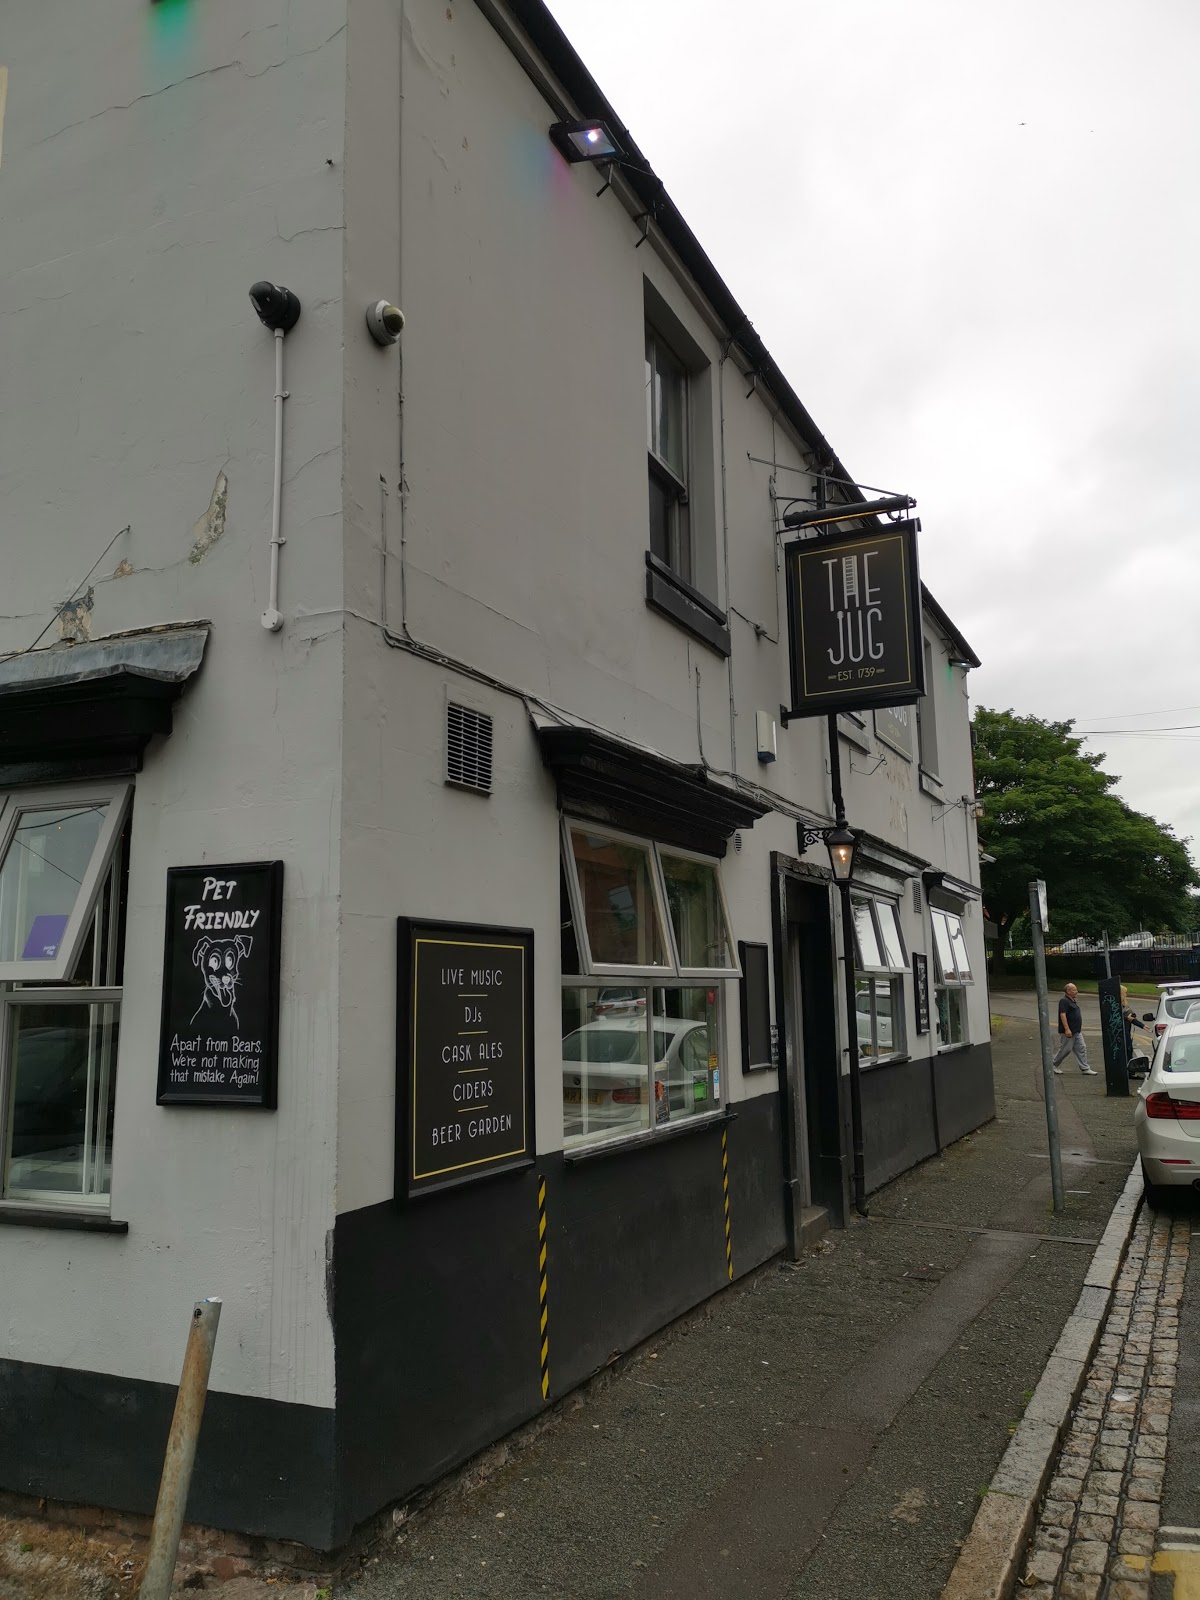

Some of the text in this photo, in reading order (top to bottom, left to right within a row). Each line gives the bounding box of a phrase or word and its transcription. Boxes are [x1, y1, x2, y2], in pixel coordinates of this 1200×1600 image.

[822, 551, 881, 611] THE
[827, 607, 884, 665] JUG
[837, 666, 876, 681] EST. 1739
[202, 877, 237, 901] PET
[184, 905, 260, 931] FRIENDLY
[441, 968, 503, 986] LIVE MUSIC
[465, 1006, 482, 1023] DJs
[170, 1033, 263, 1054] Apart from Bears.
[441, 1042, 503, 1064] CASK ALES
[172, 1052, 260, 1072] We're not making
[170, 1069, 259, 1089] that mistake Again!
[453, 1080, 493, 1102] CIDERS
[432, 1114, 512, 1146] BEER GARDEN
